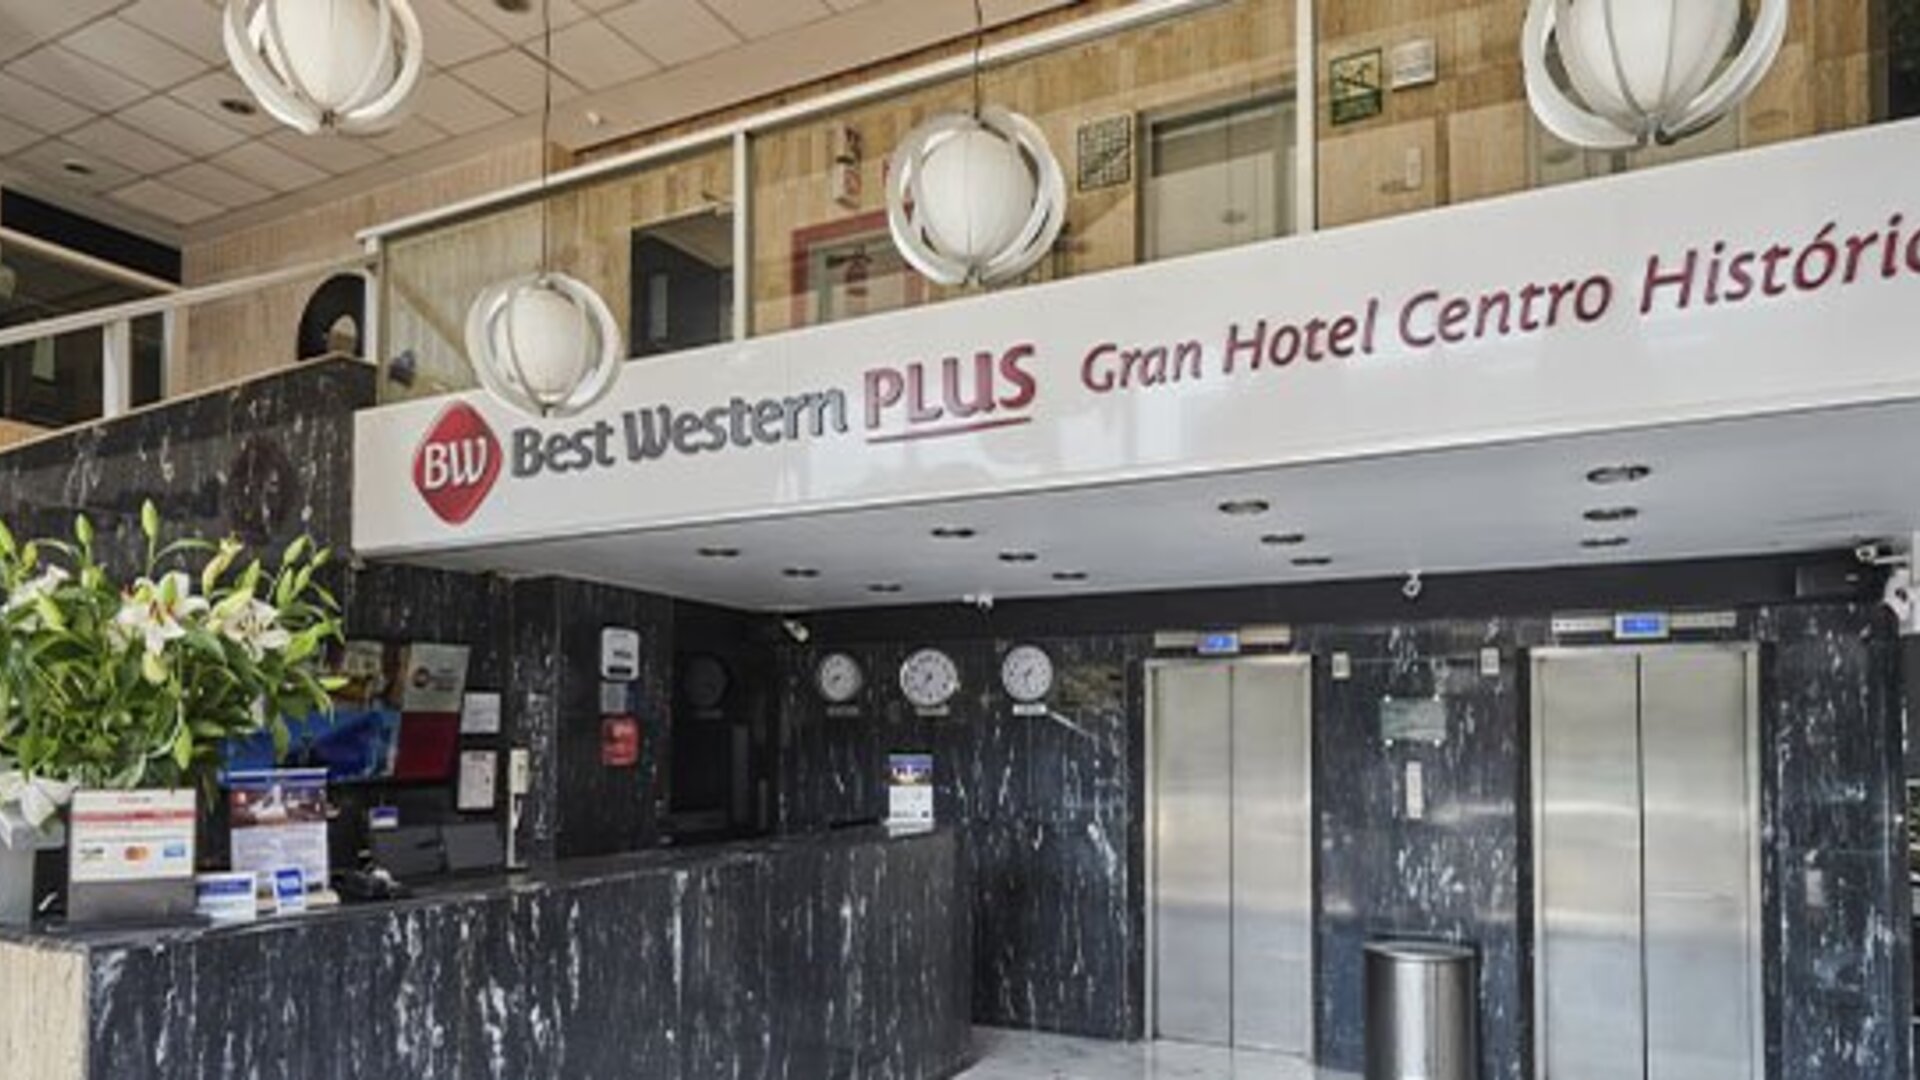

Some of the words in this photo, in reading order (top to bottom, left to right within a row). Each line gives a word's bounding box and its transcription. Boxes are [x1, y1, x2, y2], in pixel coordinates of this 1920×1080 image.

[1081, 340, 1202, 393] Gran
[1222, 298, 1380, 374] Hotel
[1399, 274, 1614, 348] Centro
[421, 436, 488, 489] BW
[511, 420, 616, 479] Best
[621, 389, 849, 463] Western
[864, 343, 1037, 429] PLUS
